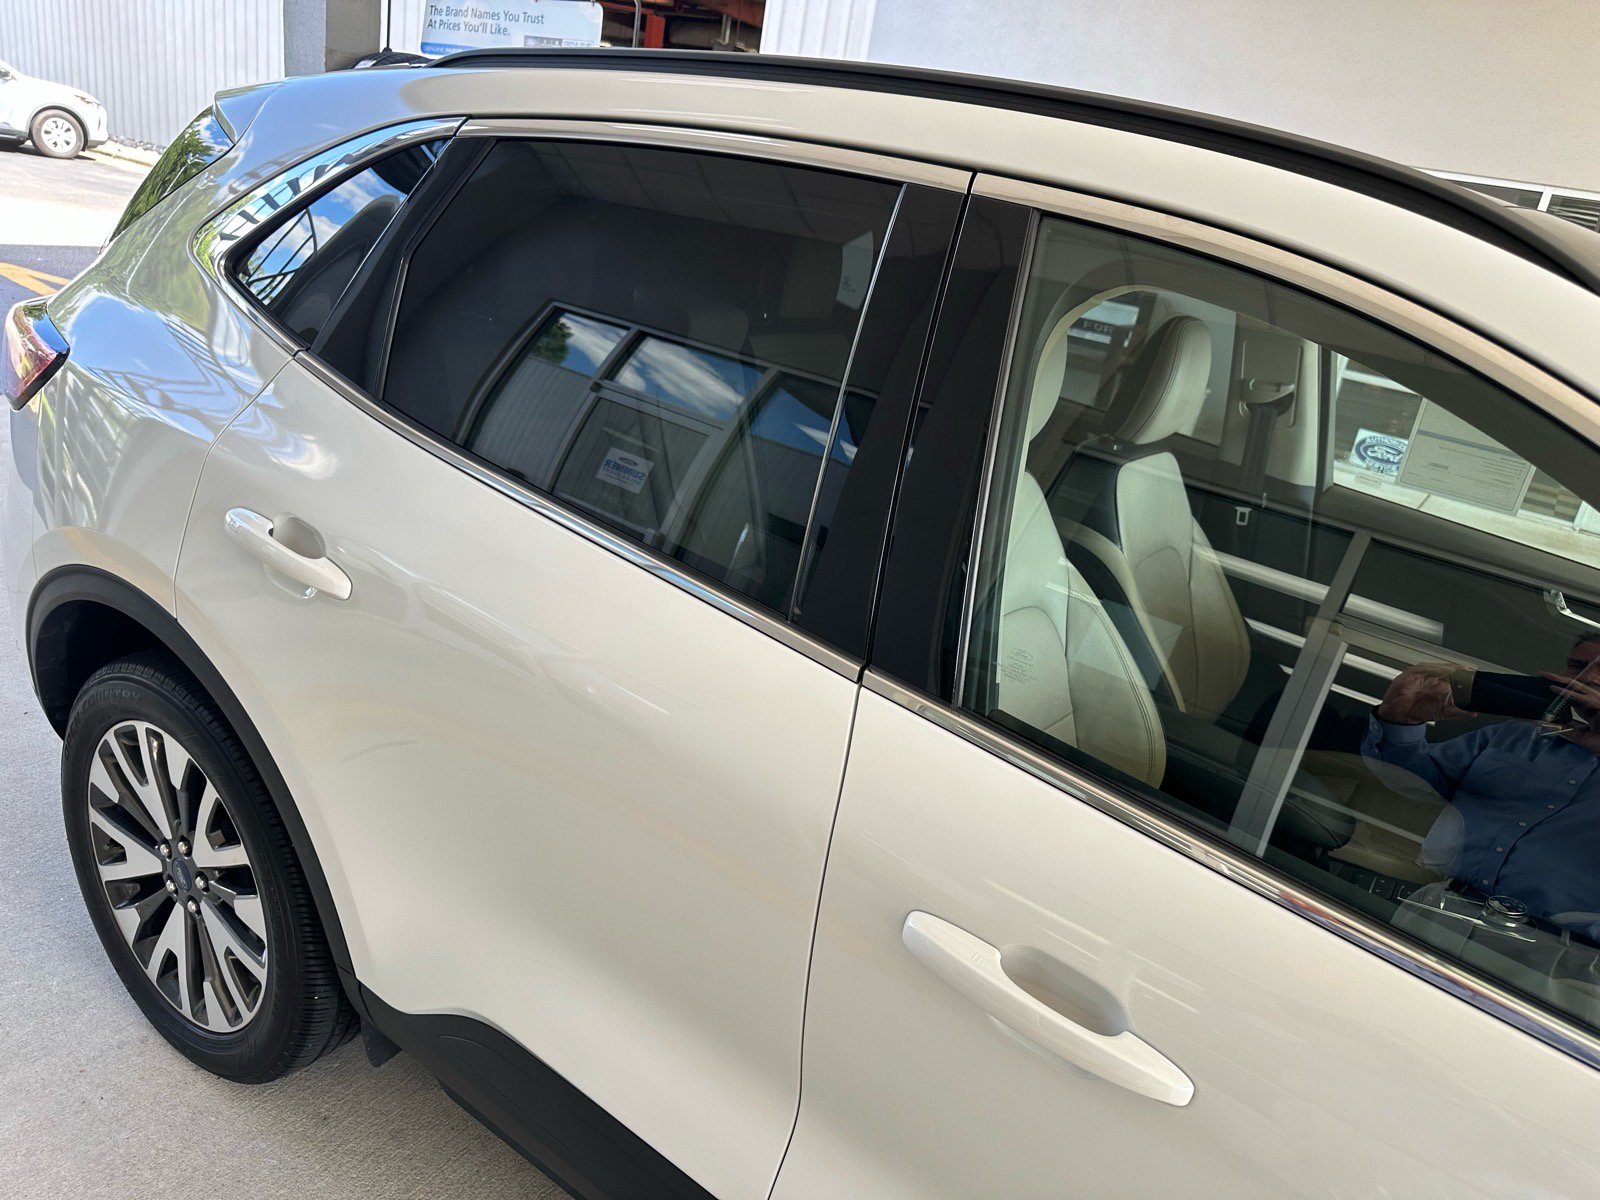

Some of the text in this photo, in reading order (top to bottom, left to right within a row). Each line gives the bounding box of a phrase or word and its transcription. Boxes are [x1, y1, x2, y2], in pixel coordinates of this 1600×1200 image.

[429, 5, 545, 24] The Brand Names You Trust
[427, 19, 510, 36] At Prices You'll Like.
